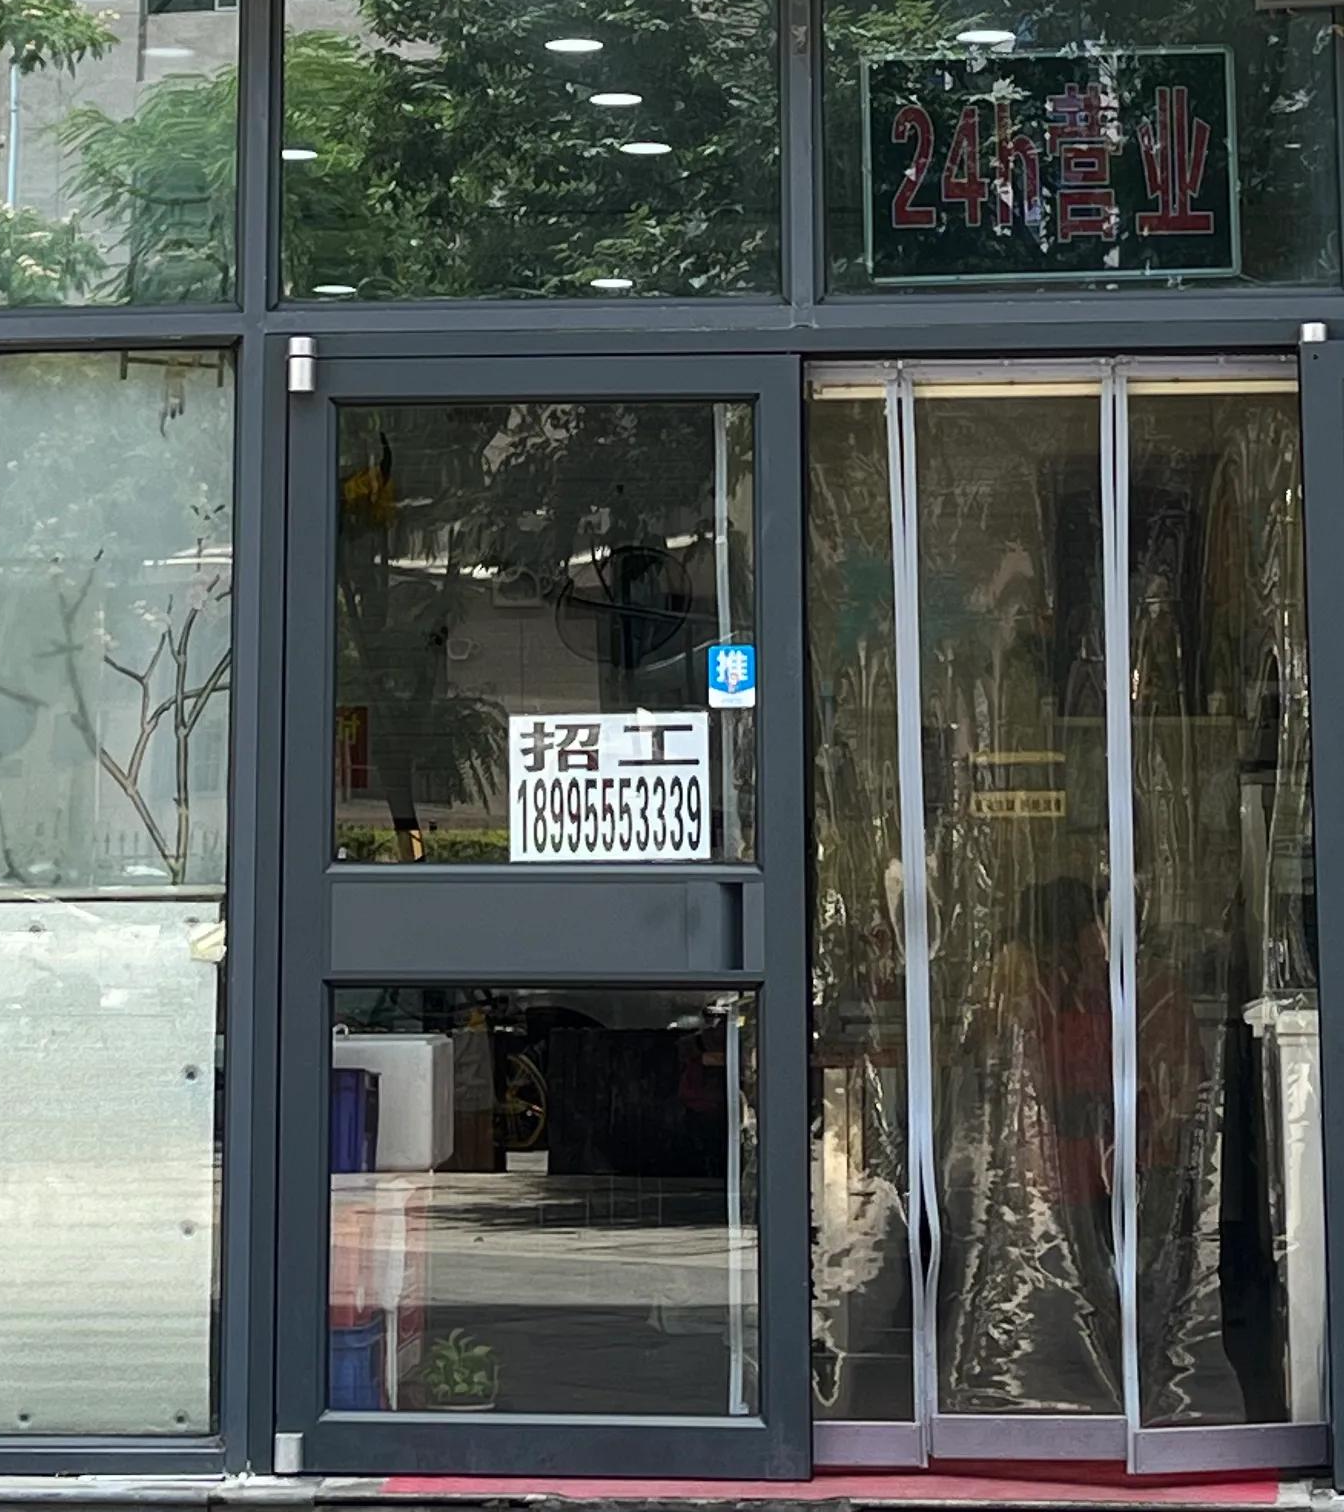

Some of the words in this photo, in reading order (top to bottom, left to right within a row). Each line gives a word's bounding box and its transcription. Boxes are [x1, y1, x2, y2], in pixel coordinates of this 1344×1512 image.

[891, 84, 1215, 244] 24h营业
[716, 649, 749, 685] 推
[519, 721, 701, 773] 招工
[516, 774, 702, 854] 18995553339
